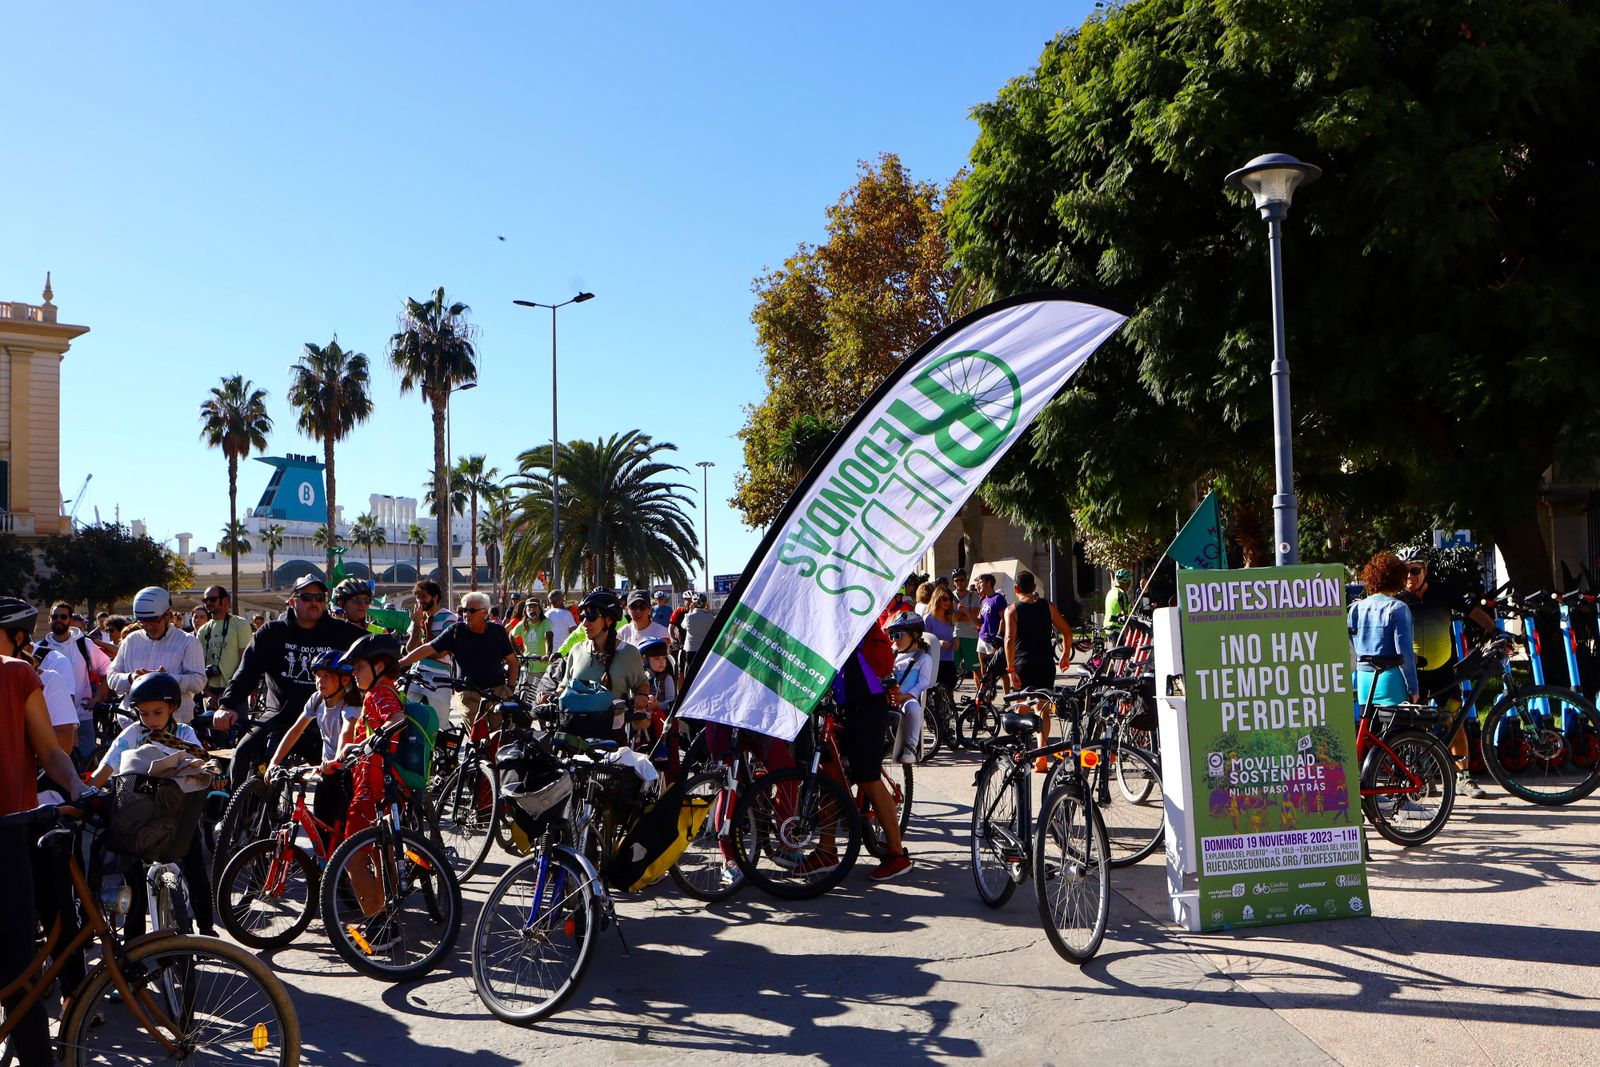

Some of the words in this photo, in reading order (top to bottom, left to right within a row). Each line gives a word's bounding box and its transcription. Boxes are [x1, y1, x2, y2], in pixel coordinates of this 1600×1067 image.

[303, 485, 311, 501] B
[1185, 572, 1341, 613] BICIFESTACIÓN
[1220, 633, 1262, 665] ¡NO
[1272, 631, 1319, 662] HAY
[1195, 665, 1290, 700] TIEMPO
[1299, 663, 1346, 695] QUE
[1221, 696, 1326, 732] PERDER!
[1231, 753, 1316, 772] MOVILIDAD
[1229, 766, 1325, 785] SOSTENIBLE
[1229, 787, 1240, 797] NI
[1244, 787, 1258, 796] UN
[1263, 784, 1289, 794] PASO
[1293, 779, 1326, 793] ATRÁS
[1204, 837, 1244, 852] DOMINGO
[1246, 836, 1257, 849] 19
[1259, 832, 1309, 848] NOVIEMBRE
[1310, 830, 1333, 844] 2023
[1205, 851, 1235, 861] EXPLANADA
[1235, 850, 1246, 858] DEL
[1300, 844, 1330, 853] EXPLANADA
[1330, 843, 1339, 851] DEL
[1340, 842, 1359, 850] PUERTO
[1206, 850, 1360, 873] RUEDASREDONDAS.ORG/BICIFESTACION
